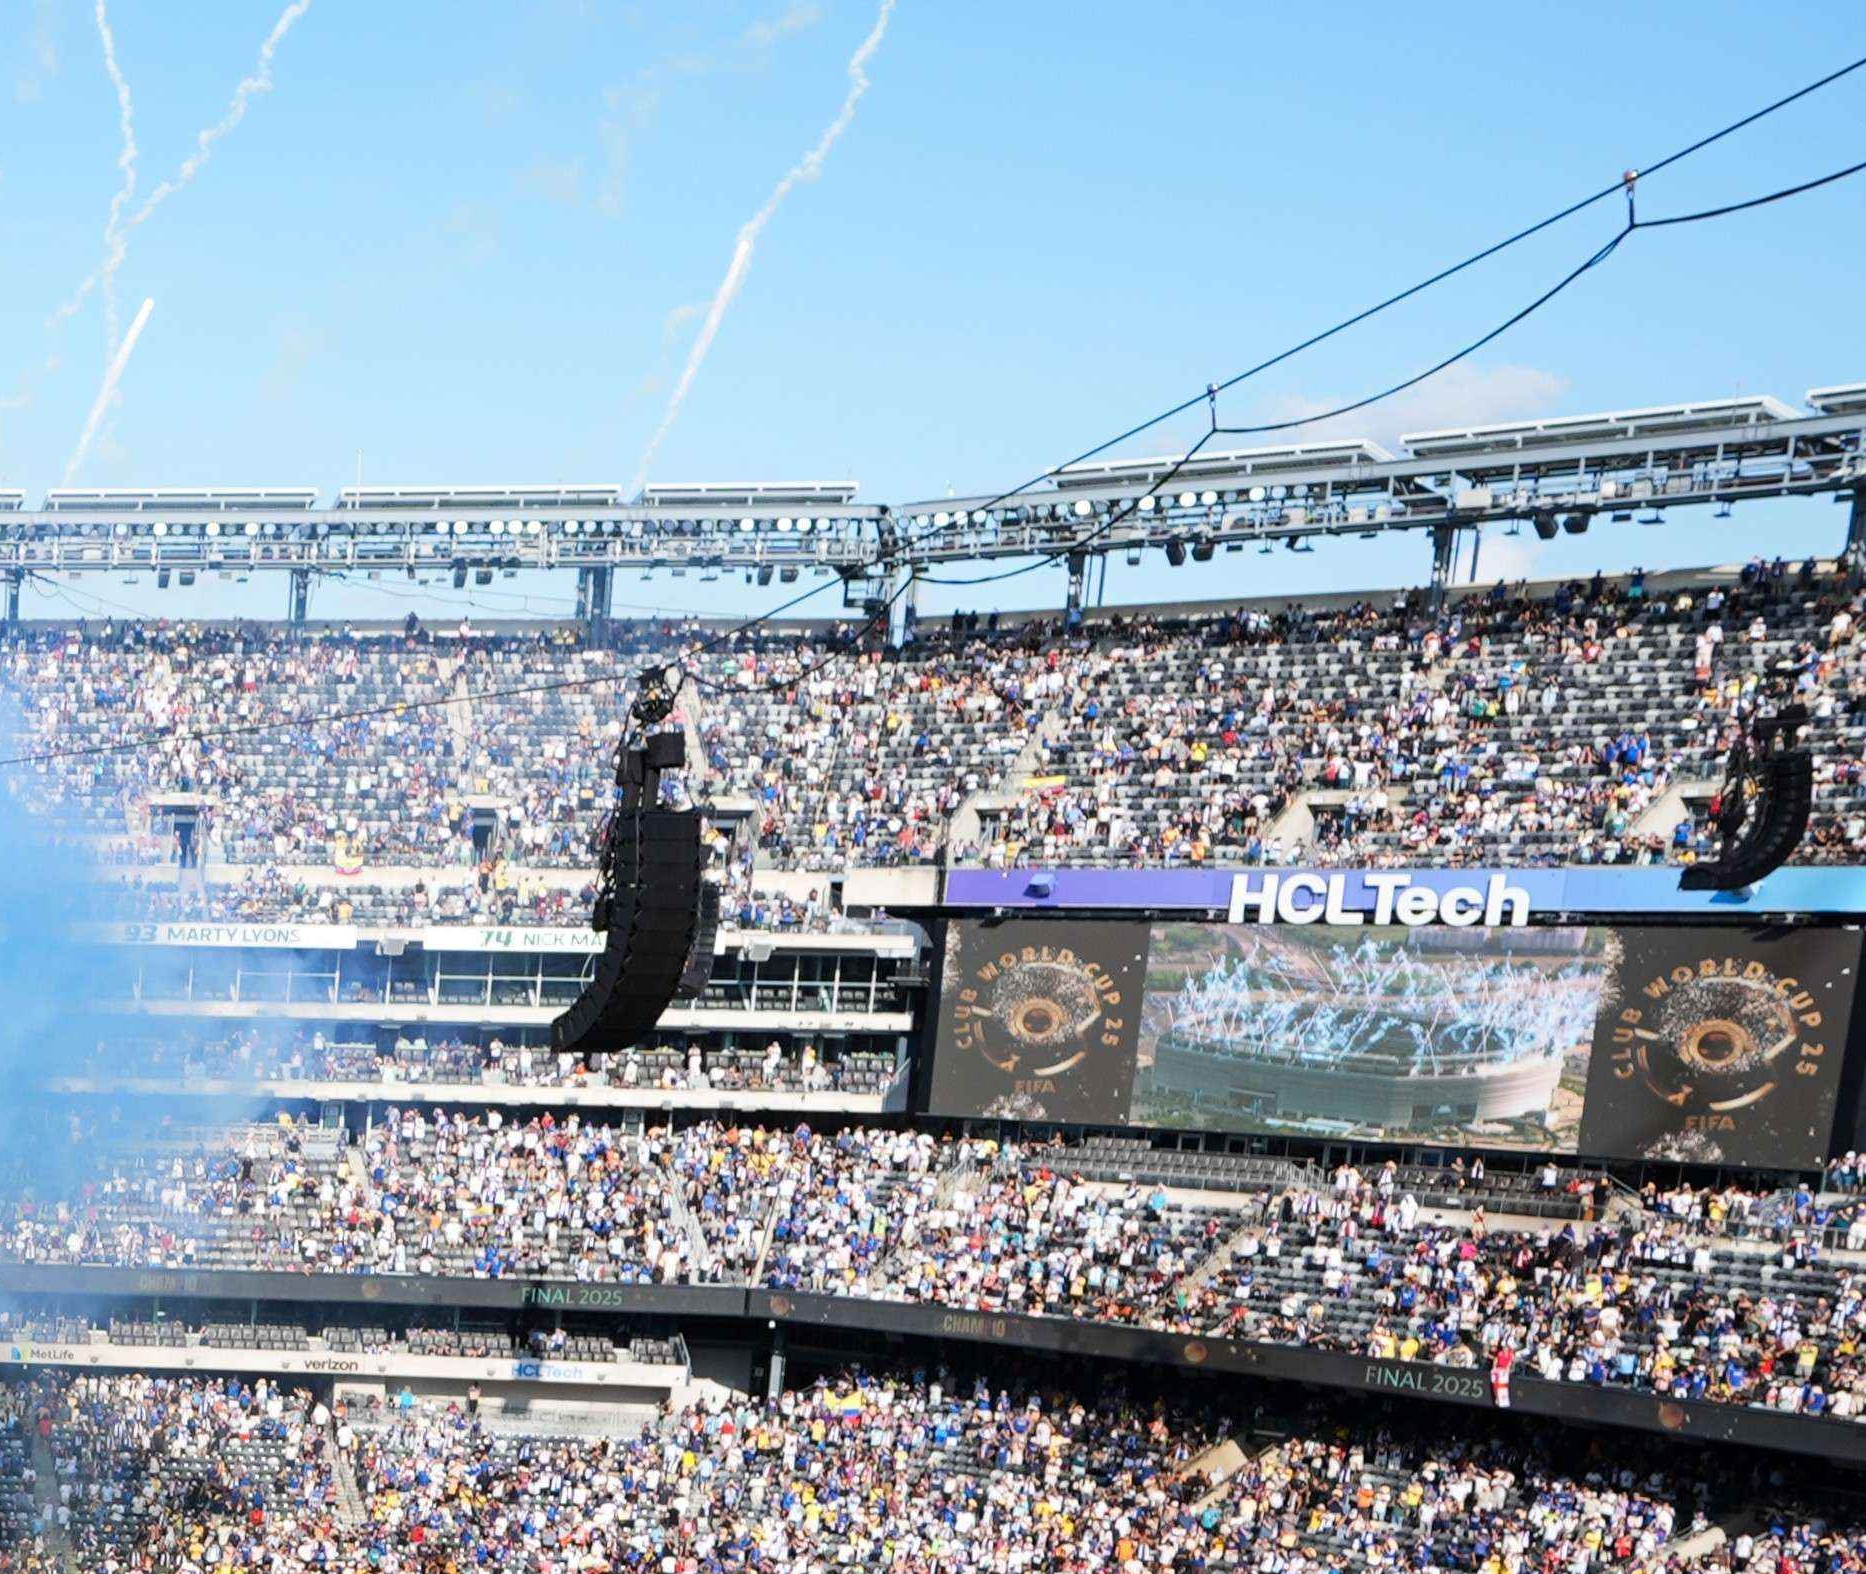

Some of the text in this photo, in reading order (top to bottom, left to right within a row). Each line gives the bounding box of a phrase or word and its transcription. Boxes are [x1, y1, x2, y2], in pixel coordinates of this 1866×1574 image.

[1228, 873, 1530, 926] HCLTech
[168, 926, 238, 941] MARTY
[242, 927, 302, 942] LYONS
[480, 930, 512, 947] 74
[954, 946, 1124, 1049] CLUB WORLD CUP 25
[1611, 957, 1825, 1080] CLUB WORLD CUP 25
[1013, 1079, 1057, 1093] FIFA
[1684, 1114, 1736, 1131] FIFA
[521, 1286, 623, 1306] FINAL 2025
[29, 1349, 75, 1361] MetLife
[304, 1355, 359, 1371] verizon
[511, 1363, 583, 1380] HCLTech
[1365, 1365, 1485, 1399] FINAL 2025
